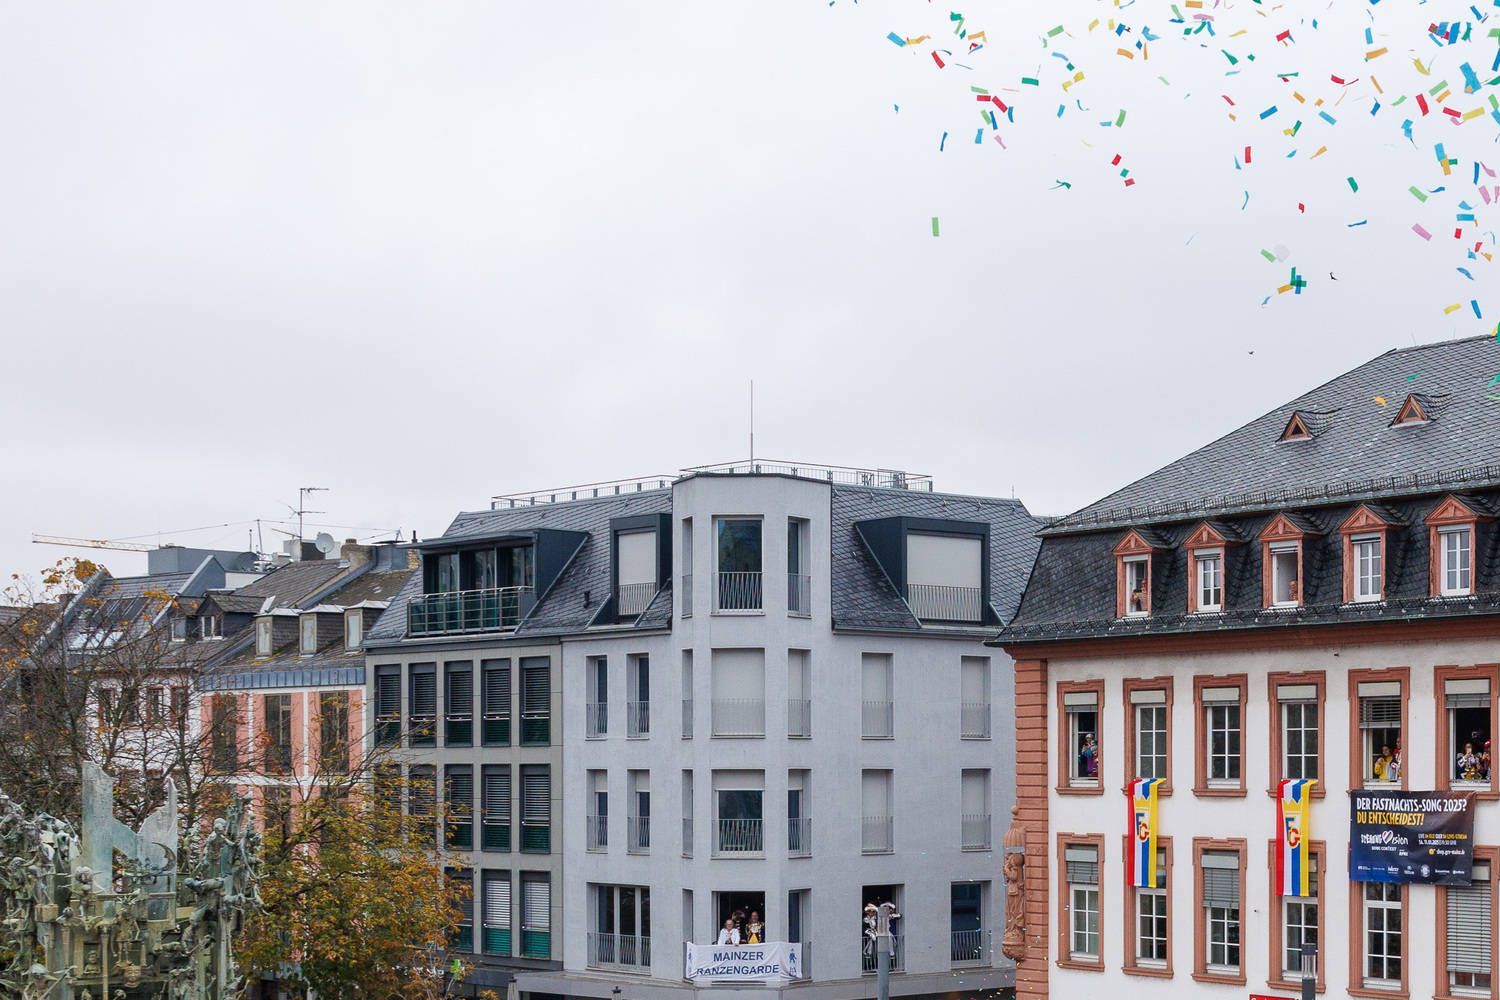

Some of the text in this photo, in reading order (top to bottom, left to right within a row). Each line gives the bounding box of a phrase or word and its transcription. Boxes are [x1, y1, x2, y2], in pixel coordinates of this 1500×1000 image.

[1356, 797, 1467, 812] DER FASTNACHTS-SONG 2025?
[1356, 812, 1424, 826] DU ENTSCHEIDEST!
[713, 950, 764, 962] MAINZER
[696, 964, 780, 976] RANZENGARDE
